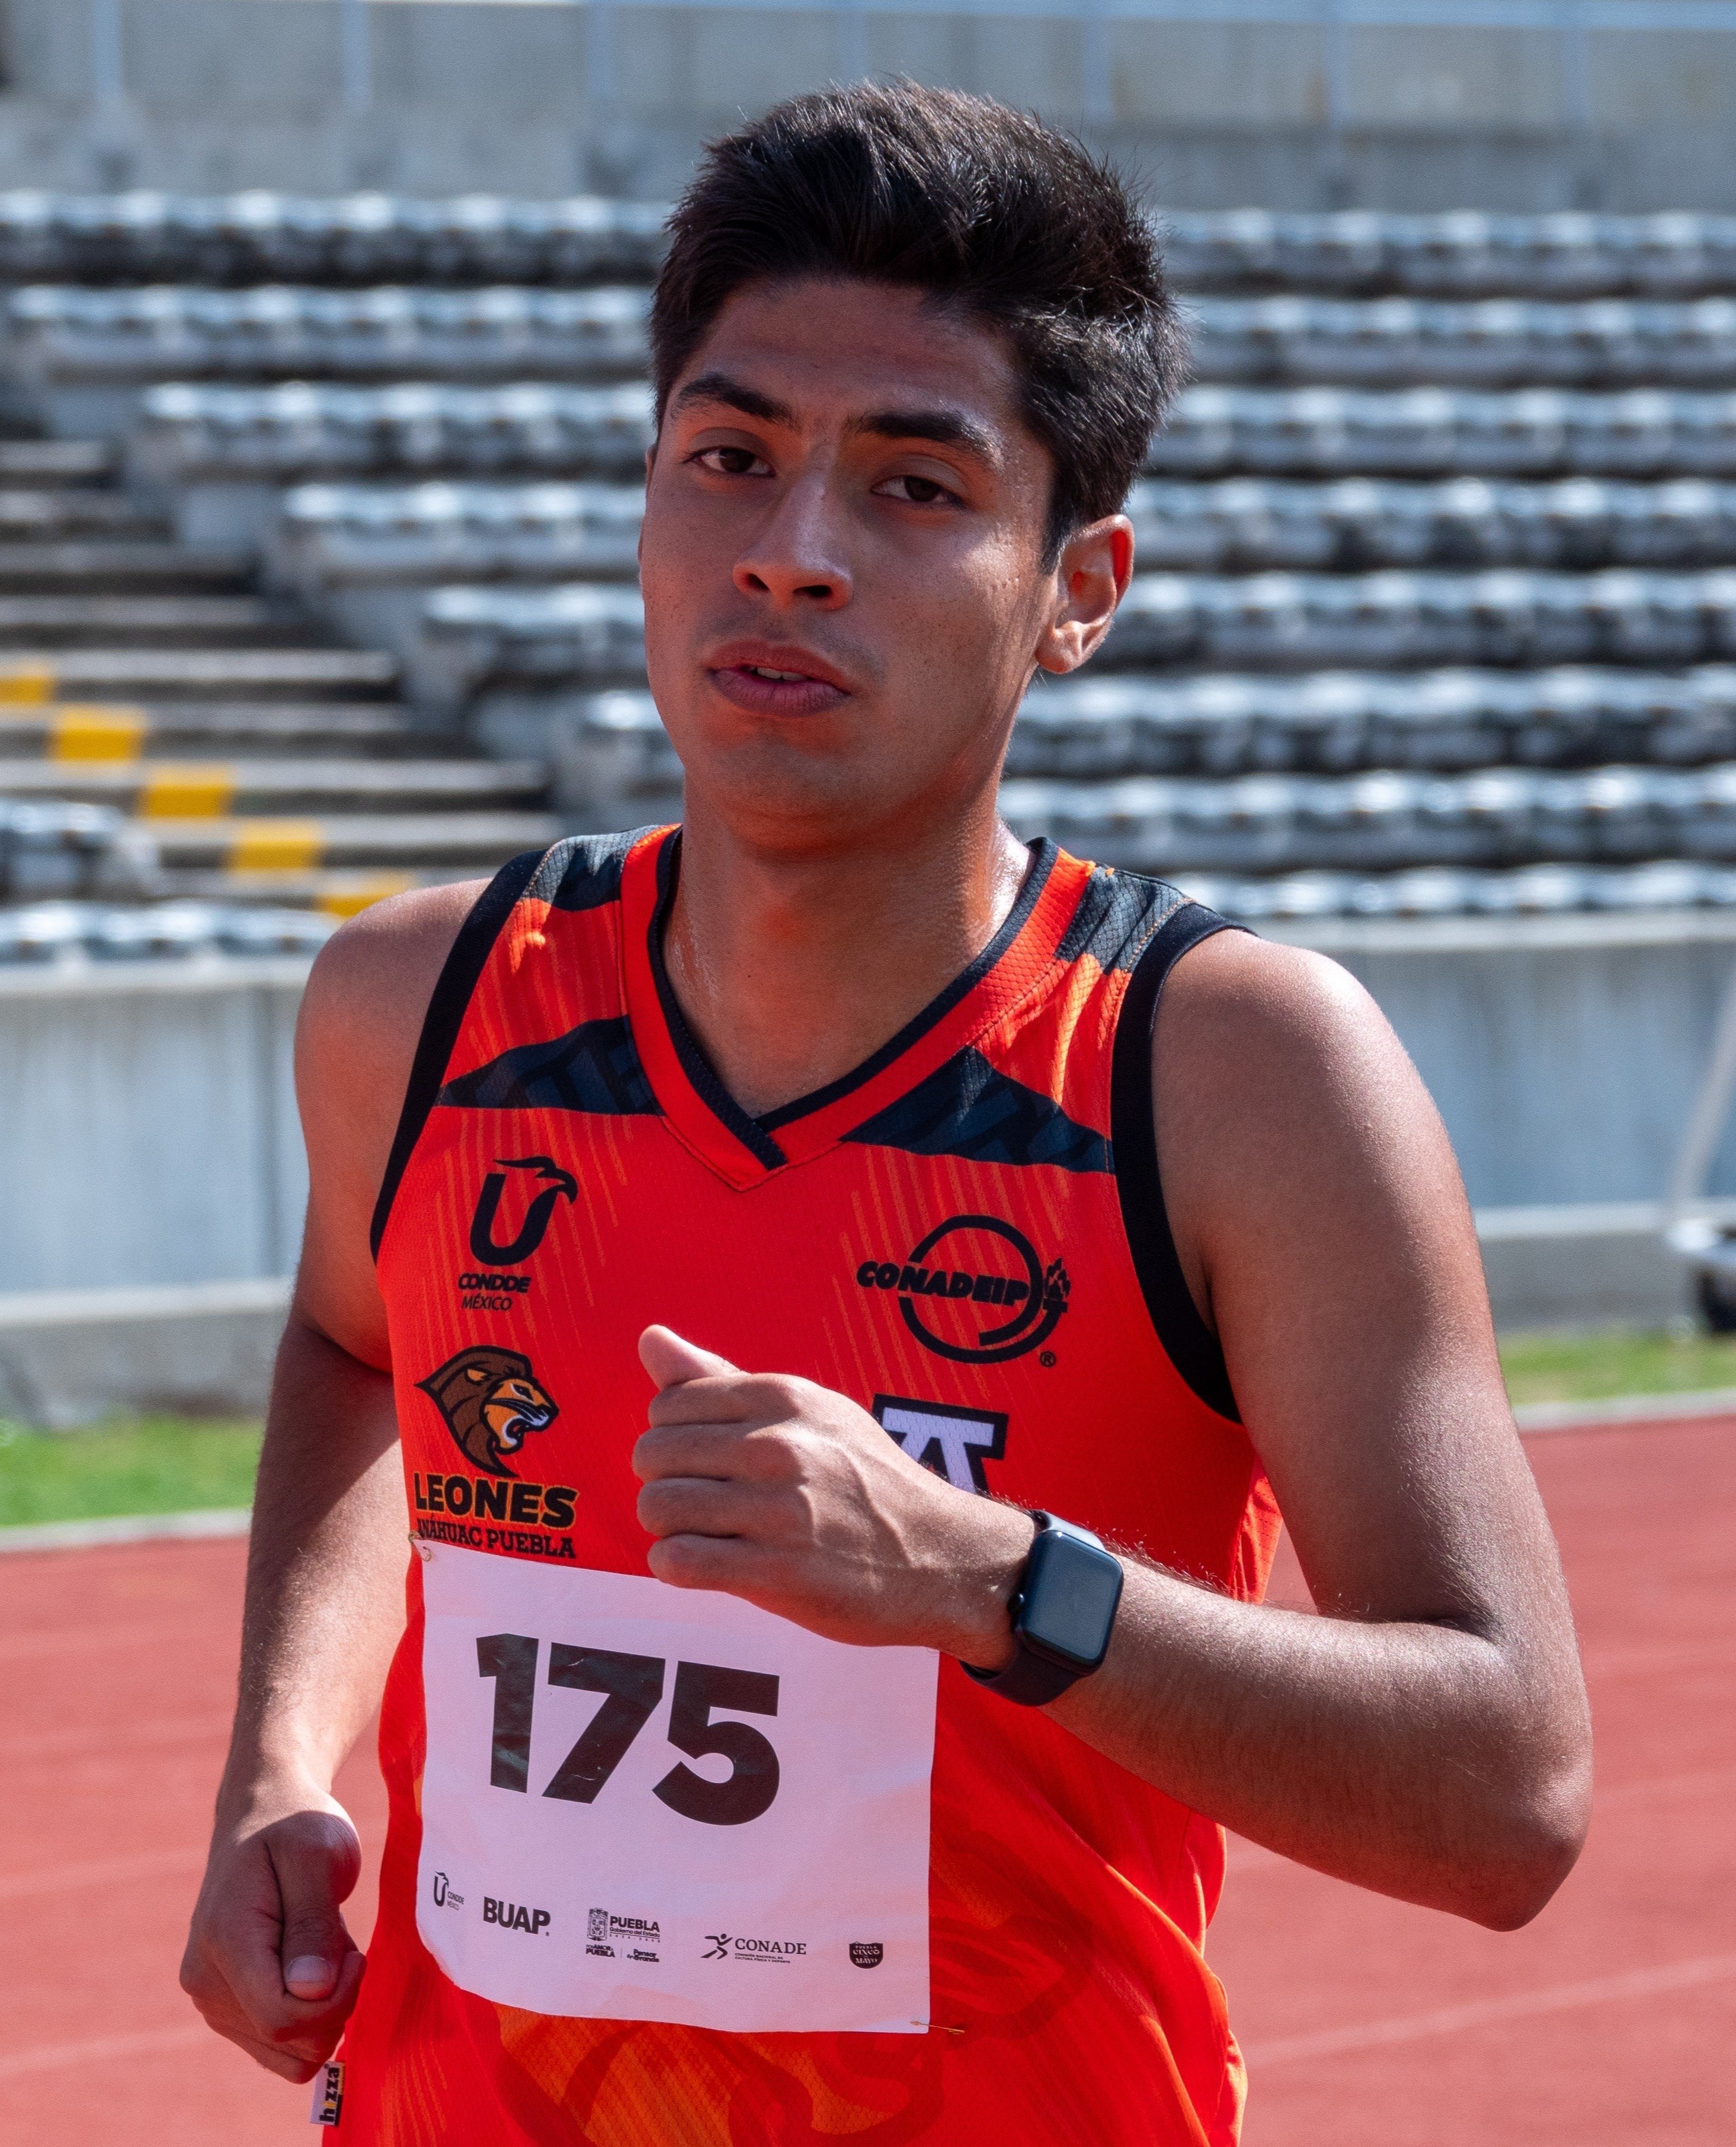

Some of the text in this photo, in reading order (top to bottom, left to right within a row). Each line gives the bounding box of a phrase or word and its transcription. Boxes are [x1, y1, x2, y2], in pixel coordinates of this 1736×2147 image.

[458, 1272, 531, 1293] CONDDE
[857, 1260, 1030, 1306] CONADEIP
[461, 1293, 513, 1311] MÉXICO
[414, 1472, 579, 1530] LEONES
[486, 1529, 576, 1559] PUEBLA
[476, 1633, 780, 1826] 175
[610, 1915, 661, 1933] PUEBLA
[586, 1948, 616, 1958] PUEBLA
[735, 1938, 807, 1955] CONADE
